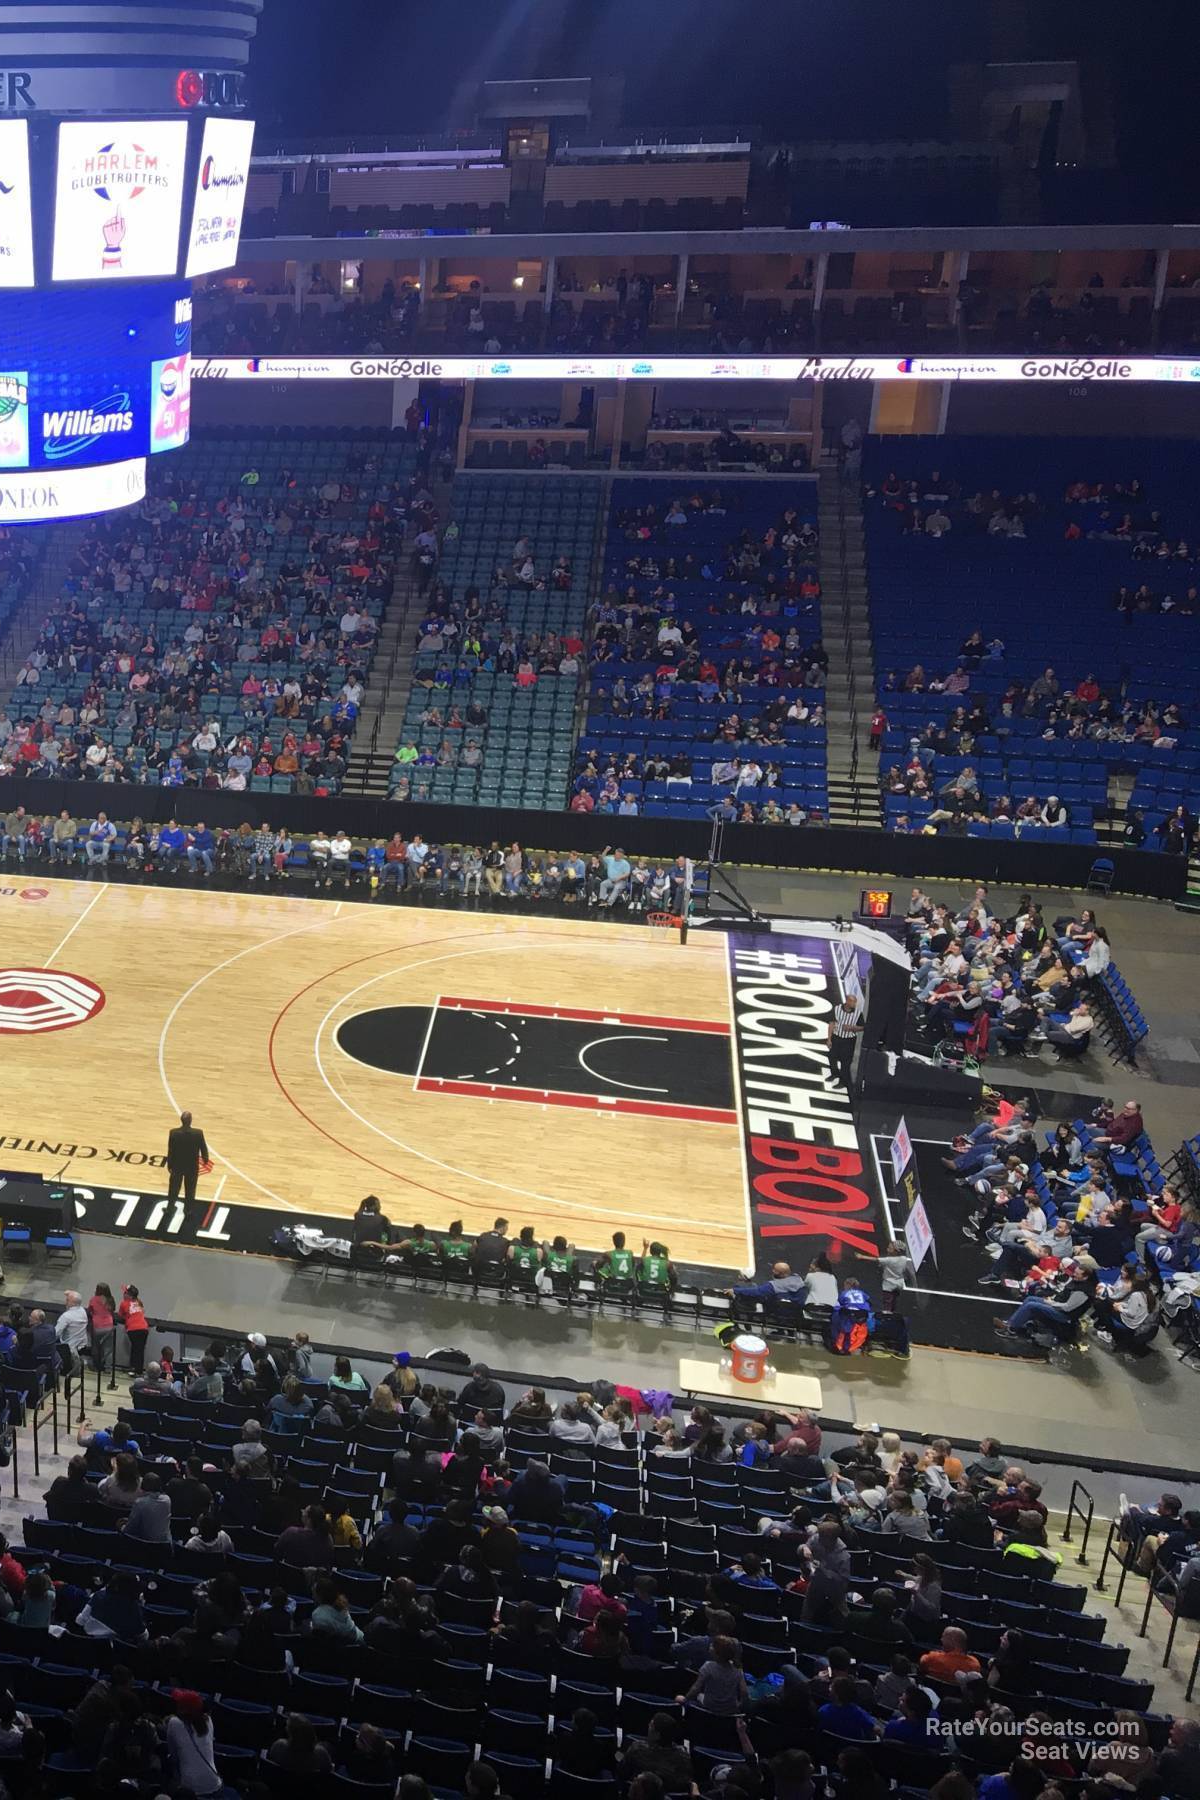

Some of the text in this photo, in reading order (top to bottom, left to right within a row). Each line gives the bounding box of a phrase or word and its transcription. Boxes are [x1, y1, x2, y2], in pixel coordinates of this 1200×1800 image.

[84, 153, 158, 172] HARLEM
[71, 172, 169, 190] GLOBETROTTERS
[246, 357, 330, 379] Champion
[349, 358, 442, 378] GoNoodle
[796, 357, 876, 380] Baden
[897, 357, 998, 380] Champion
[1021, 358, 1132, 381] GoNoodle
[42, 408, 133, 439] Williams
[875, 902, 885, 914] 0
[103, 1148, 169, 1168] BOK
[618, 1260, 629, 1274] 4
[649, 1264, 659, 1278] 5
[849, 1293, 863, 1304] 13
[743, 1360, 756, 1373] G
